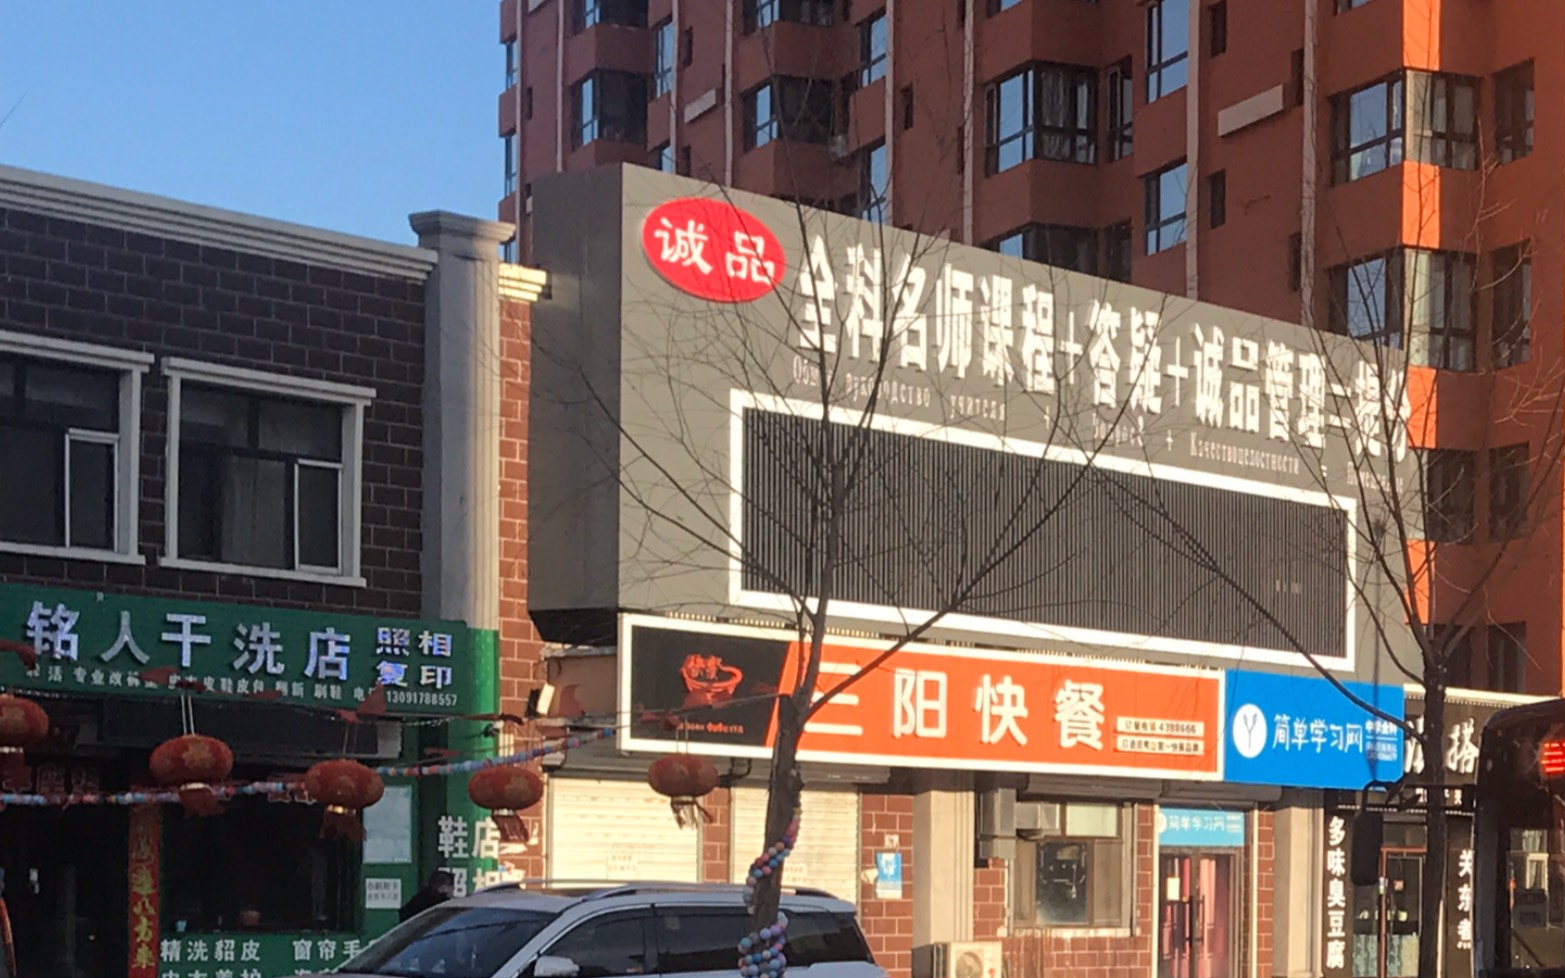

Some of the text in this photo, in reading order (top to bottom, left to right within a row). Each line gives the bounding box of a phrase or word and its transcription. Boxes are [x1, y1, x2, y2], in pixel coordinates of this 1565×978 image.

[653, 216, 776, 285] 诚品
[26, 600, 350, 681] 铭人干洗店
[375, 627, 453, 657] 照相
[375, 660, 453, 689] 复印
[804, 660, 1105, 751] 三阳快餐
[1272, 713, 1363, 754] 简单学习网
[438, 815, 500, 859] 鞋店
[1326, 815, 1346, 969] 多味臭豆腐
[293, 938, 379, 961] 窗帘毛
